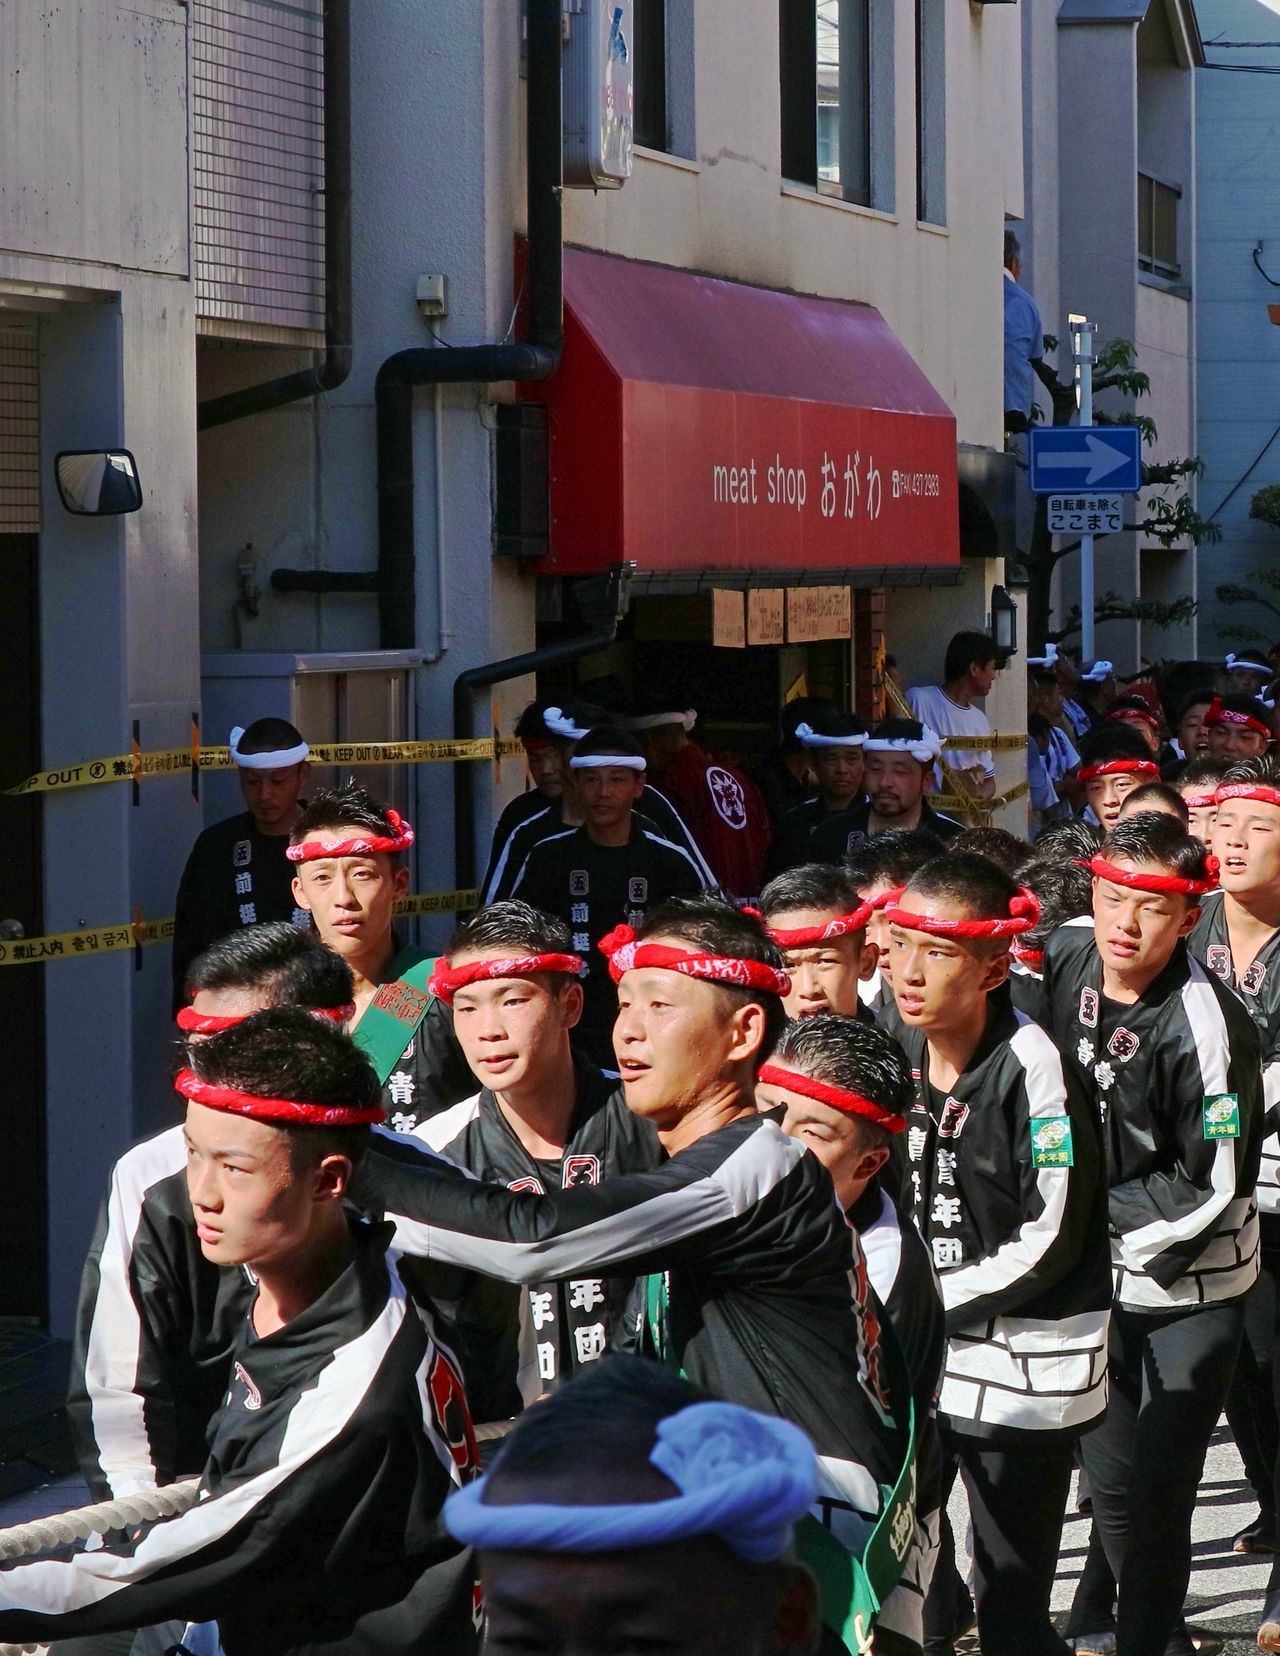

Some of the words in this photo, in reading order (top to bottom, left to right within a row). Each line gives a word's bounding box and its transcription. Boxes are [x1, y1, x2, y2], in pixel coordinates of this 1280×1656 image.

[713, 459, 758, 504] meat
[767, 453, 807, 512] shop
[821, 450, 881, 520] おがわ
[1051, 499, 1119, 512] 自転車を除く
[1051, 514, 1120, 530] ここまで
[334, 746, 354, 761] KEEP
[356, 746, 371, 761] OUT
[46, 767, 83, 786] OUT
[12, 939, 64, 960] 禁止入内
[71, 932, 98, 951] 출입
[102, 929, 130, 946] 금지
[930, 1148, 963, 1269] 青年団
